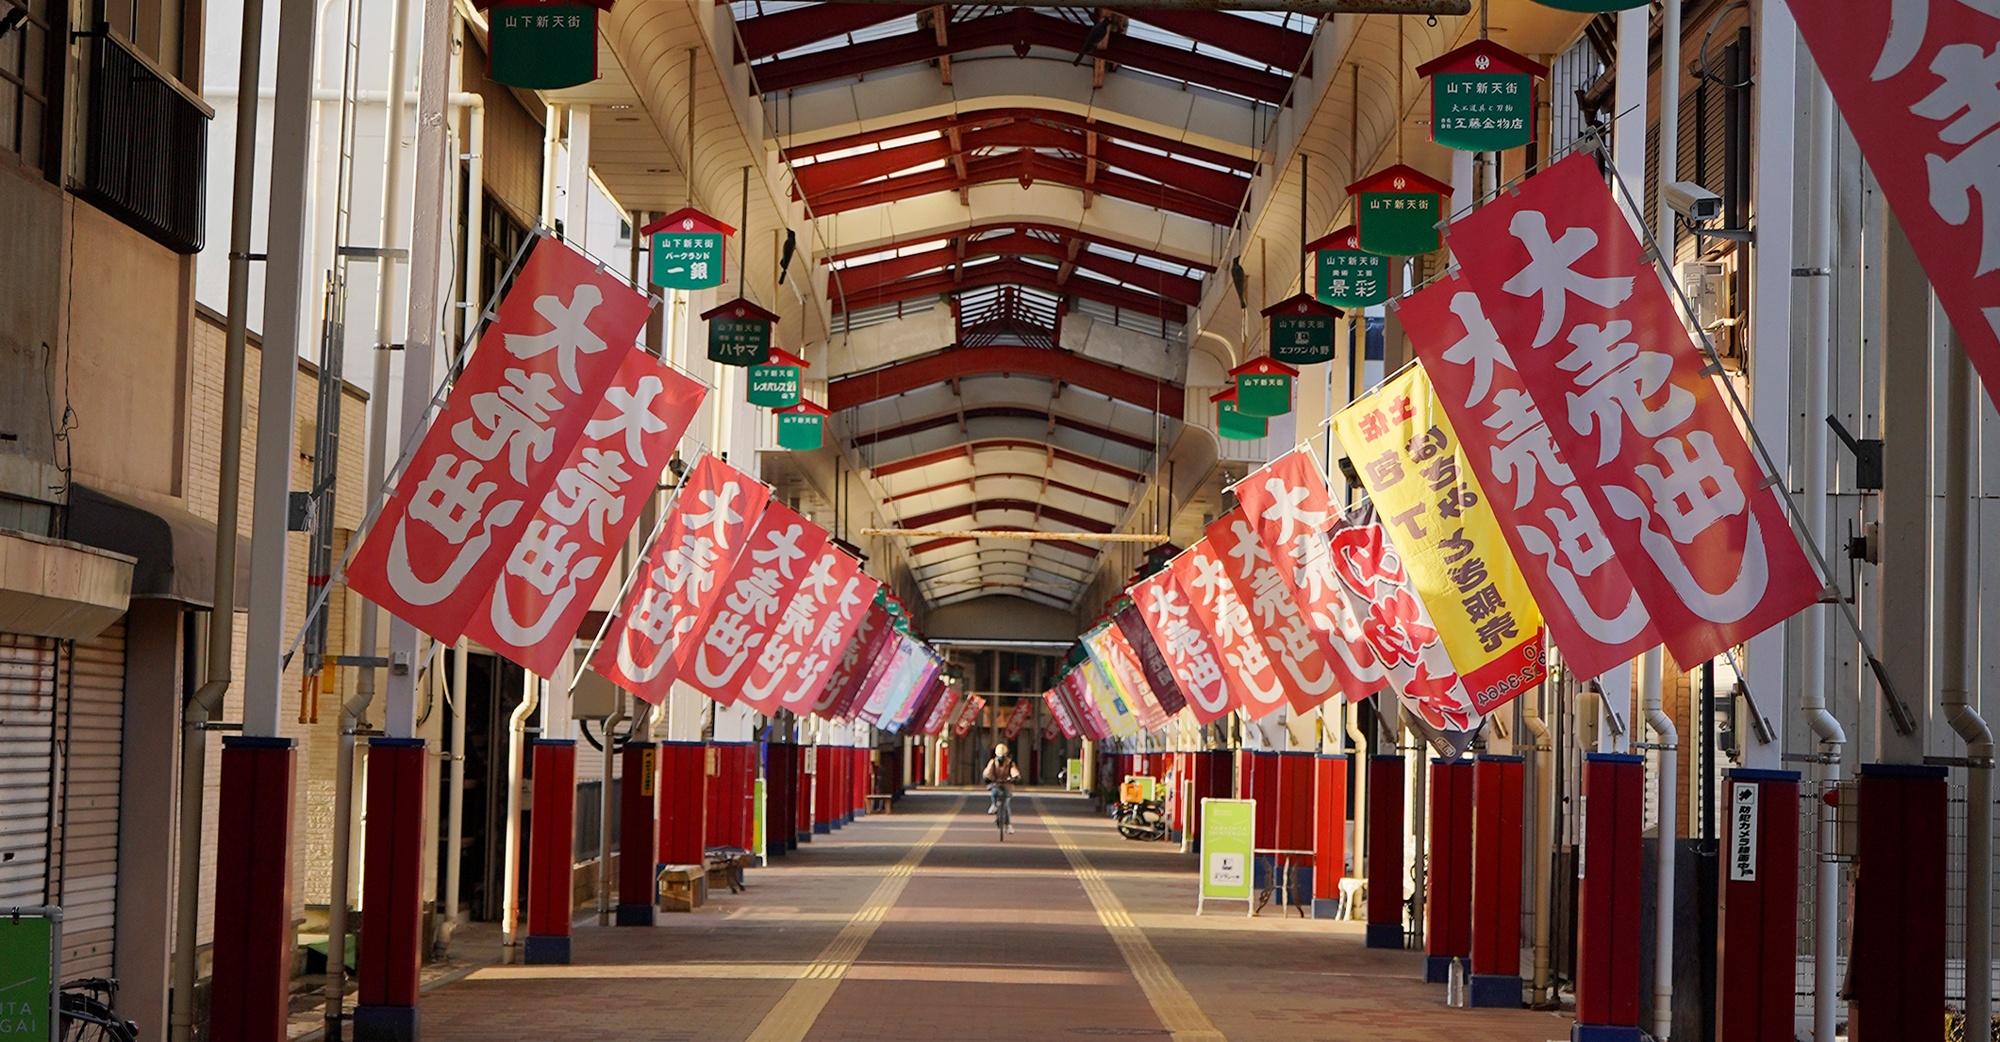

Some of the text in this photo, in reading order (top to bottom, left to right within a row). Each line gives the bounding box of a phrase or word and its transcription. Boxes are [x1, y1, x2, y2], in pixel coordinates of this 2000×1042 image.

[505, 15, 580, 28] 山下新天街
[1447, 82, 1518, 94] 山下新天街
[1370, 199, 1429, 210] 山下新天街
[662, 238, 714, 249] 山下新天街
[1326, 256, 1379, 266] 山下新天街
[667, 262, 708, 280] 一銀
[1328, 279, 1377, 297] 景彩
[718, 323, 762, 333] 山下新天街
[1279, 320, 1325, 328] 山下新天街
[719, 343, 759, 356] ハヤマ
[755, 369, 794, 377] 山下新天街
[1244, 378, 1284, 386] 山下新天街
[1502, 209, 1769, 623] 大売出し
[1192, 554, 1285, 704] 大売出し
[1148, 585, 1229, 714] 大売出し
[1736, 805, 1752, 876] 防犯カメラ録画中
